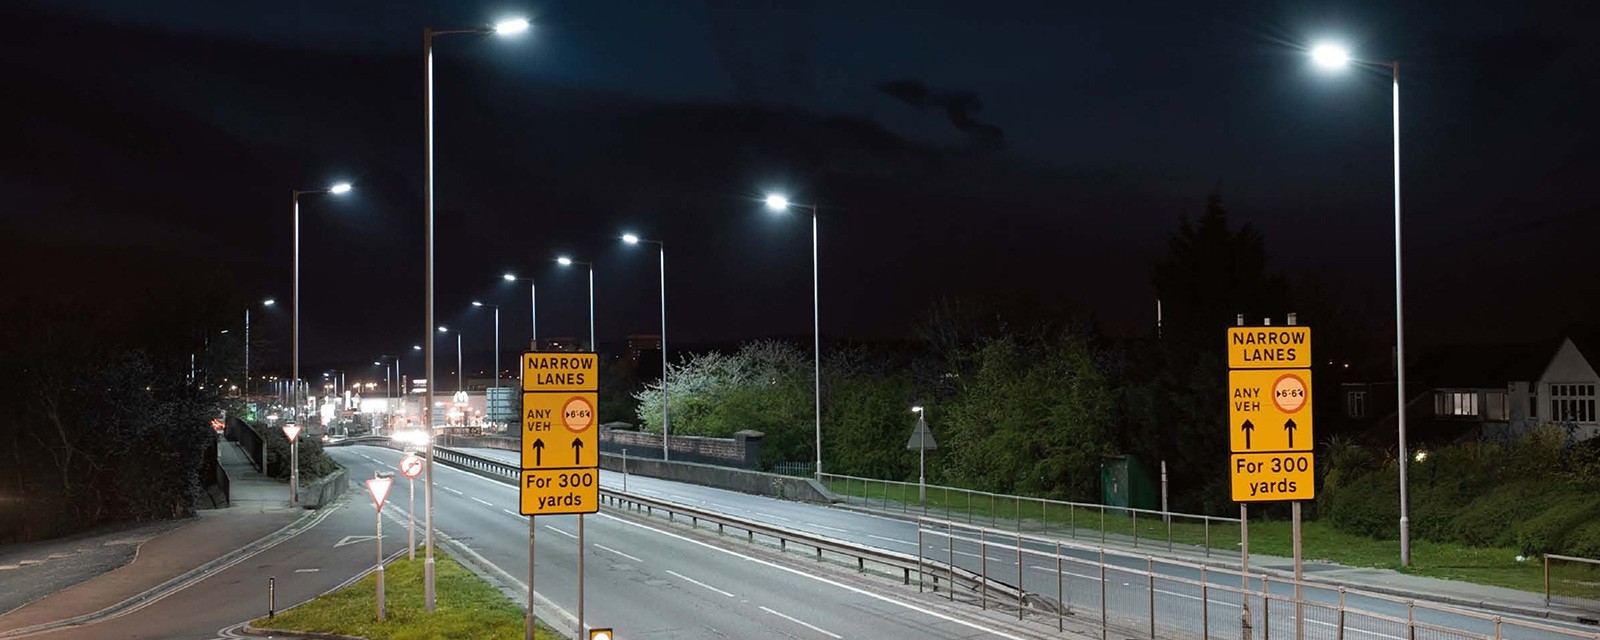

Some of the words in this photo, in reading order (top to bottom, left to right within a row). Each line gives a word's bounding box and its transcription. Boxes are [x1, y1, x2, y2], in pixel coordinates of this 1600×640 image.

[1233, 332, 1305, 345] NARROW
[1243, 348, 1297, 361] LANES
[528, 357, 593, 370] NARROW
[537, 373, 585, 385] LANES
[1234, 388, 1260, 398] ANY
[1235, 401, 1260, 412] VEH
[527, 409, 552, 419] ANY
[527, 421, 551, 431] VEH
[1236, 458, 1263, 473] For
[1271, 457, 1308, 473] 300
[526, 475, 552, 488] For
[558, 473, 593, 487] 300
[1250, 478, 1297, 496] yards
[538, 492, 582, 509] yards
